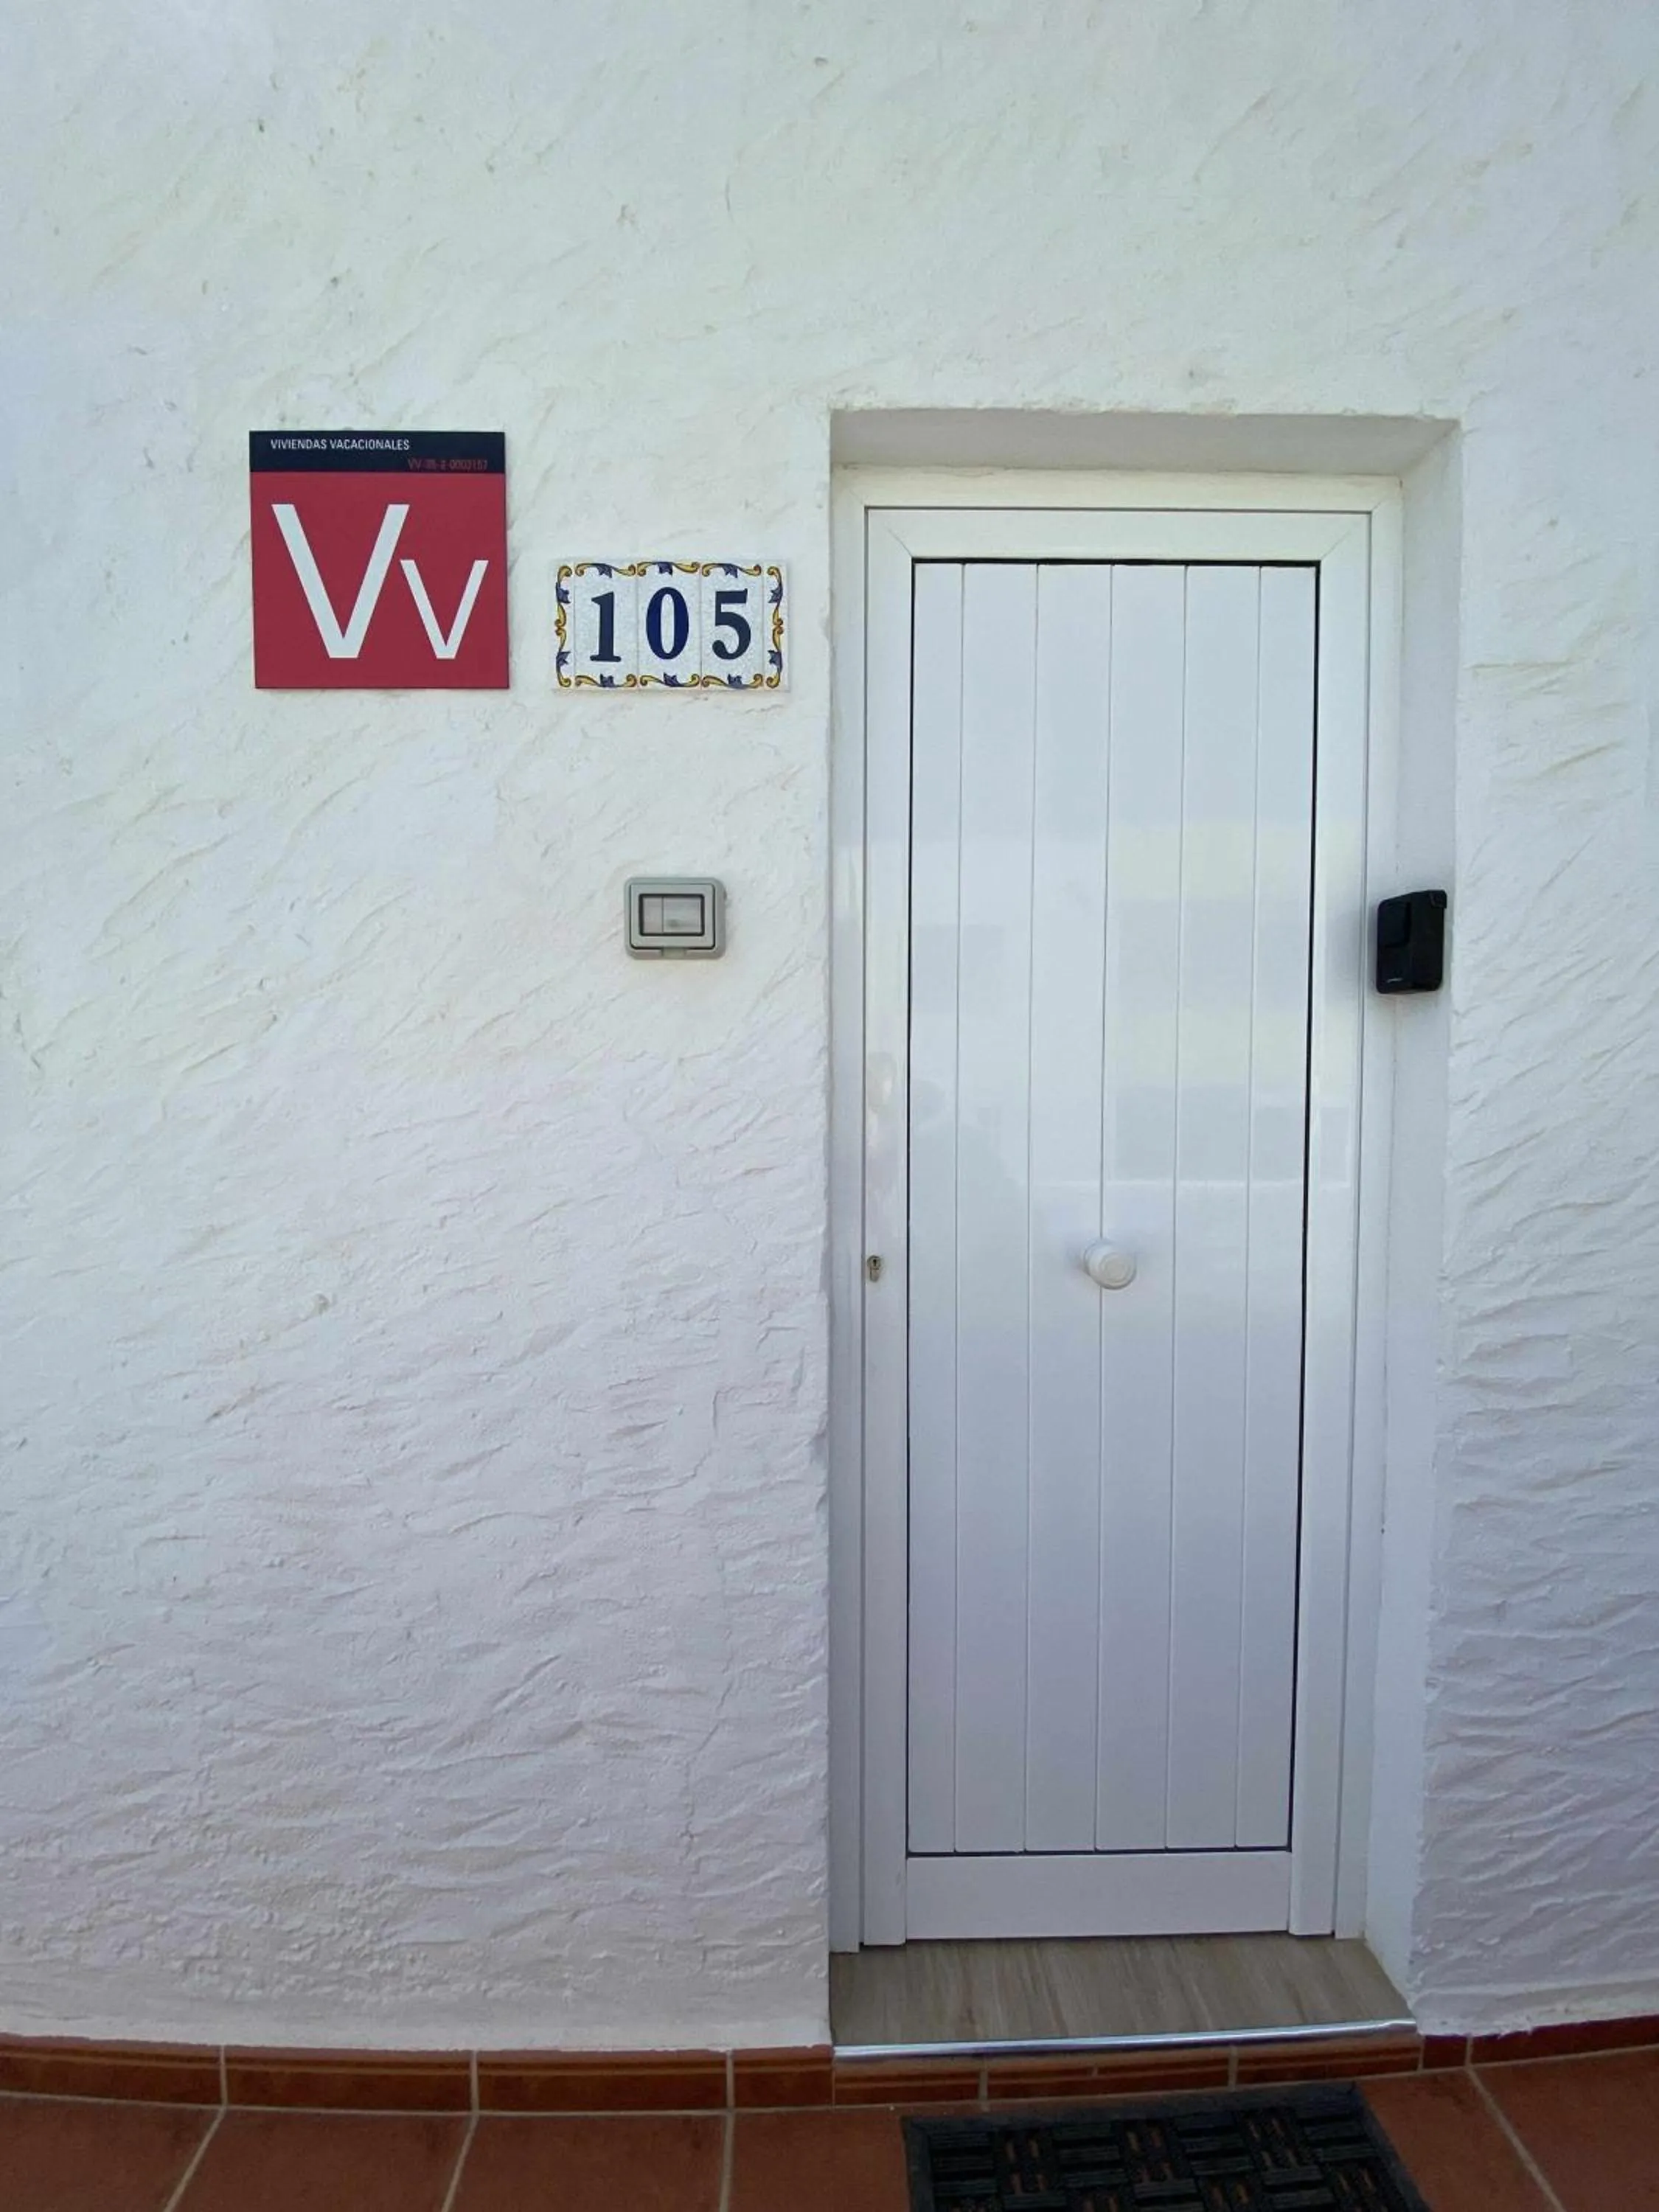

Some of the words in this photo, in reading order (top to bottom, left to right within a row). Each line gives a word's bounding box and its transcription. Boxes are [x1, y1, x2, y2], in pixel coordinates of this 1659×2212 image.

[271, 439, 327, 450] VIVIENDAS
[330, 439, 410, 451] VACACIONALES
[589, 586, 752, 663] 105
